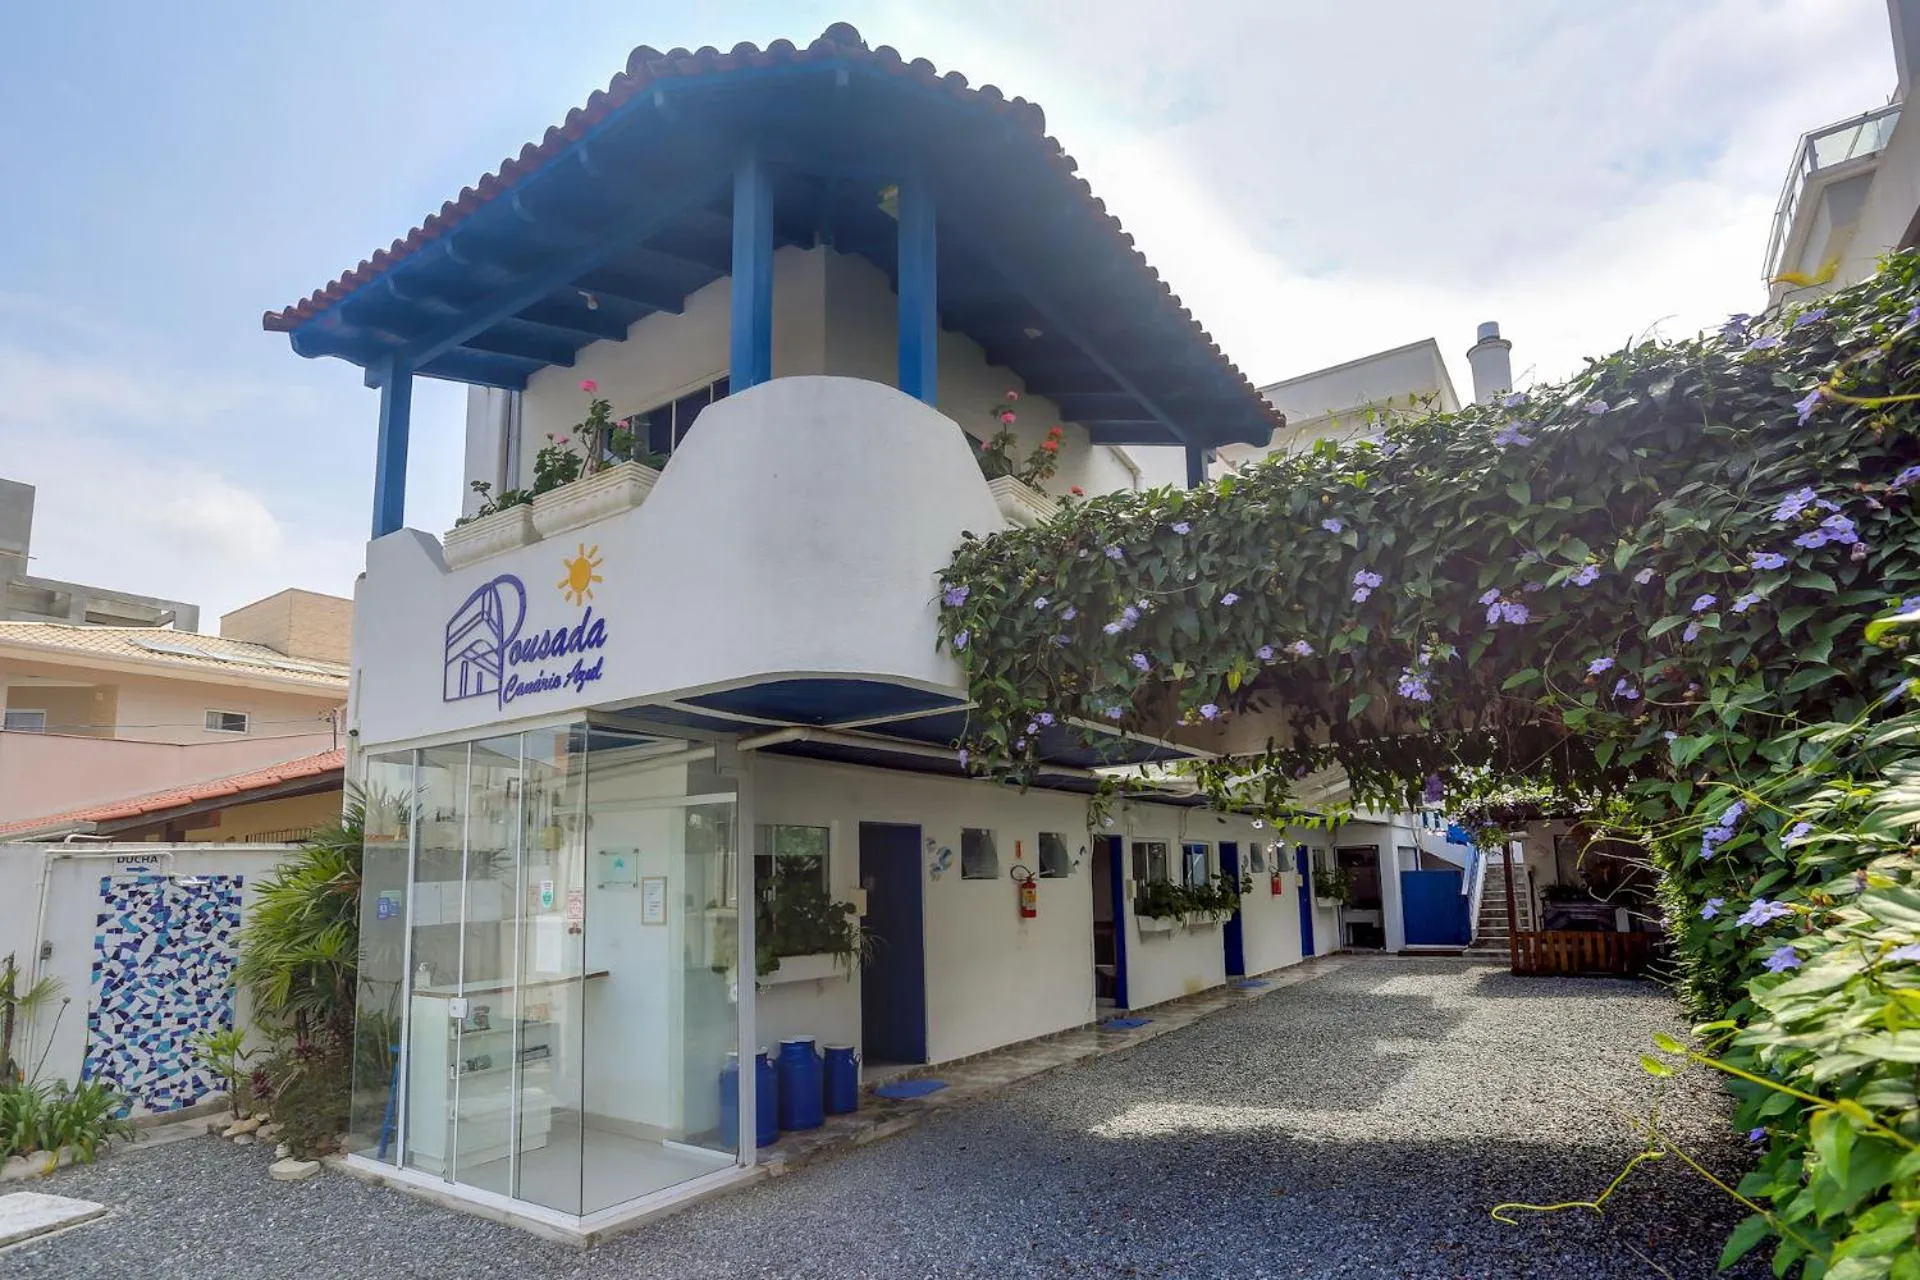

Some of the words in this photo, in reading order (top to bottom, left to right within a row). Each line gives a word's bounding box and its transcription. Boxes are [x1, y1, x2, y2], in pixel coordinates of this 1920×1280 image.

[486, 574, 608, 711] Pousada
[503, 670, 562, 703] Canário
[563, 656, 604, 693] Azul
[117, 855, 158, 864] DUCHA
